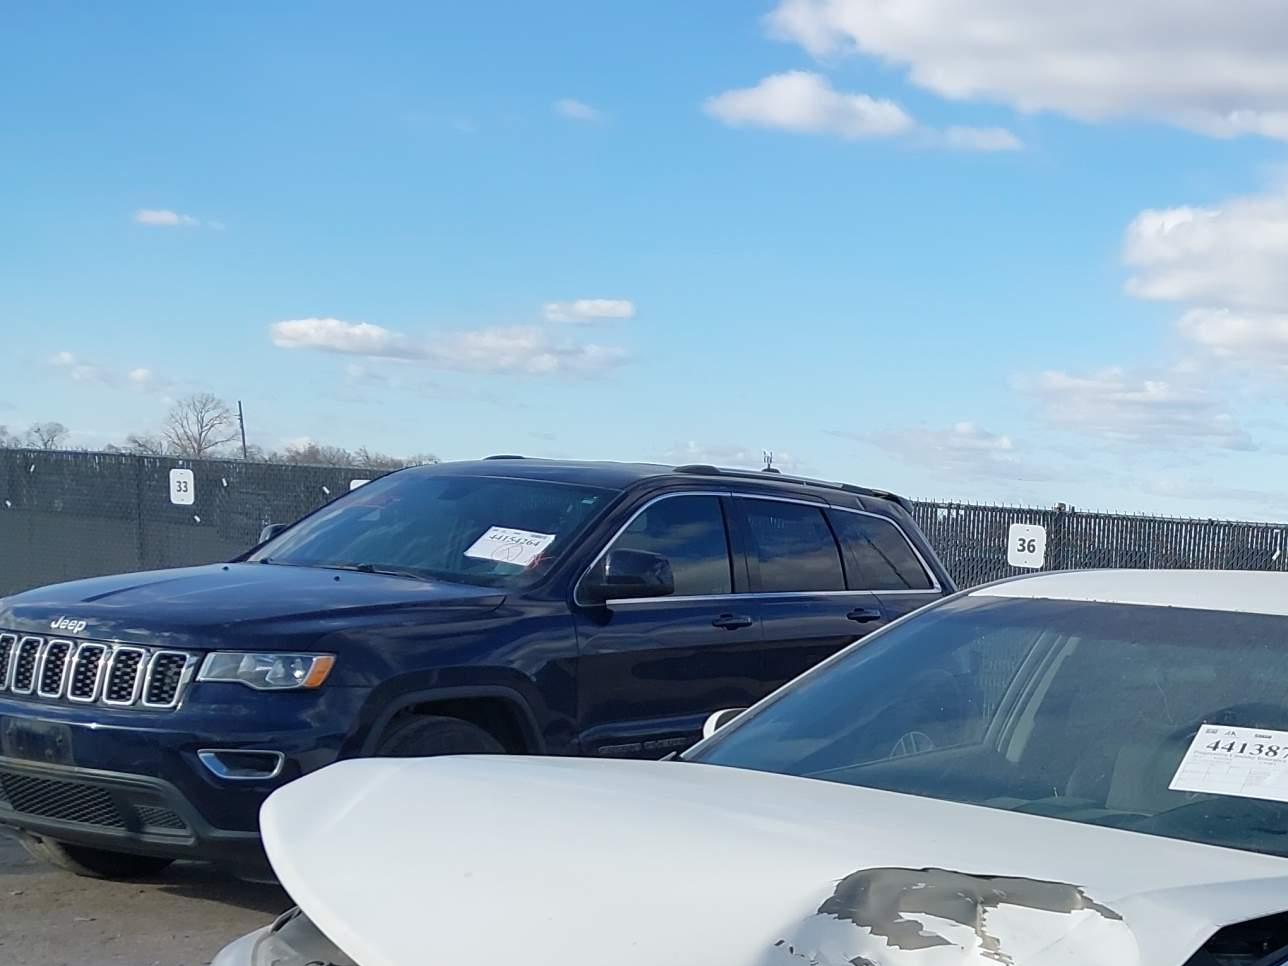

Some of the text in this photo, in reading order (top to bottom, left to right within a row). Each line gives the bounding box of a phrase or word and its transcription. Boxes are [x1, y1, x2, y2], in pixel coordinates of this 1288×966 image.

[176, 480, 189, 493] 33
[1016, 538, 1036, 554] 36
[51, 615, 87, 634] Jeep
